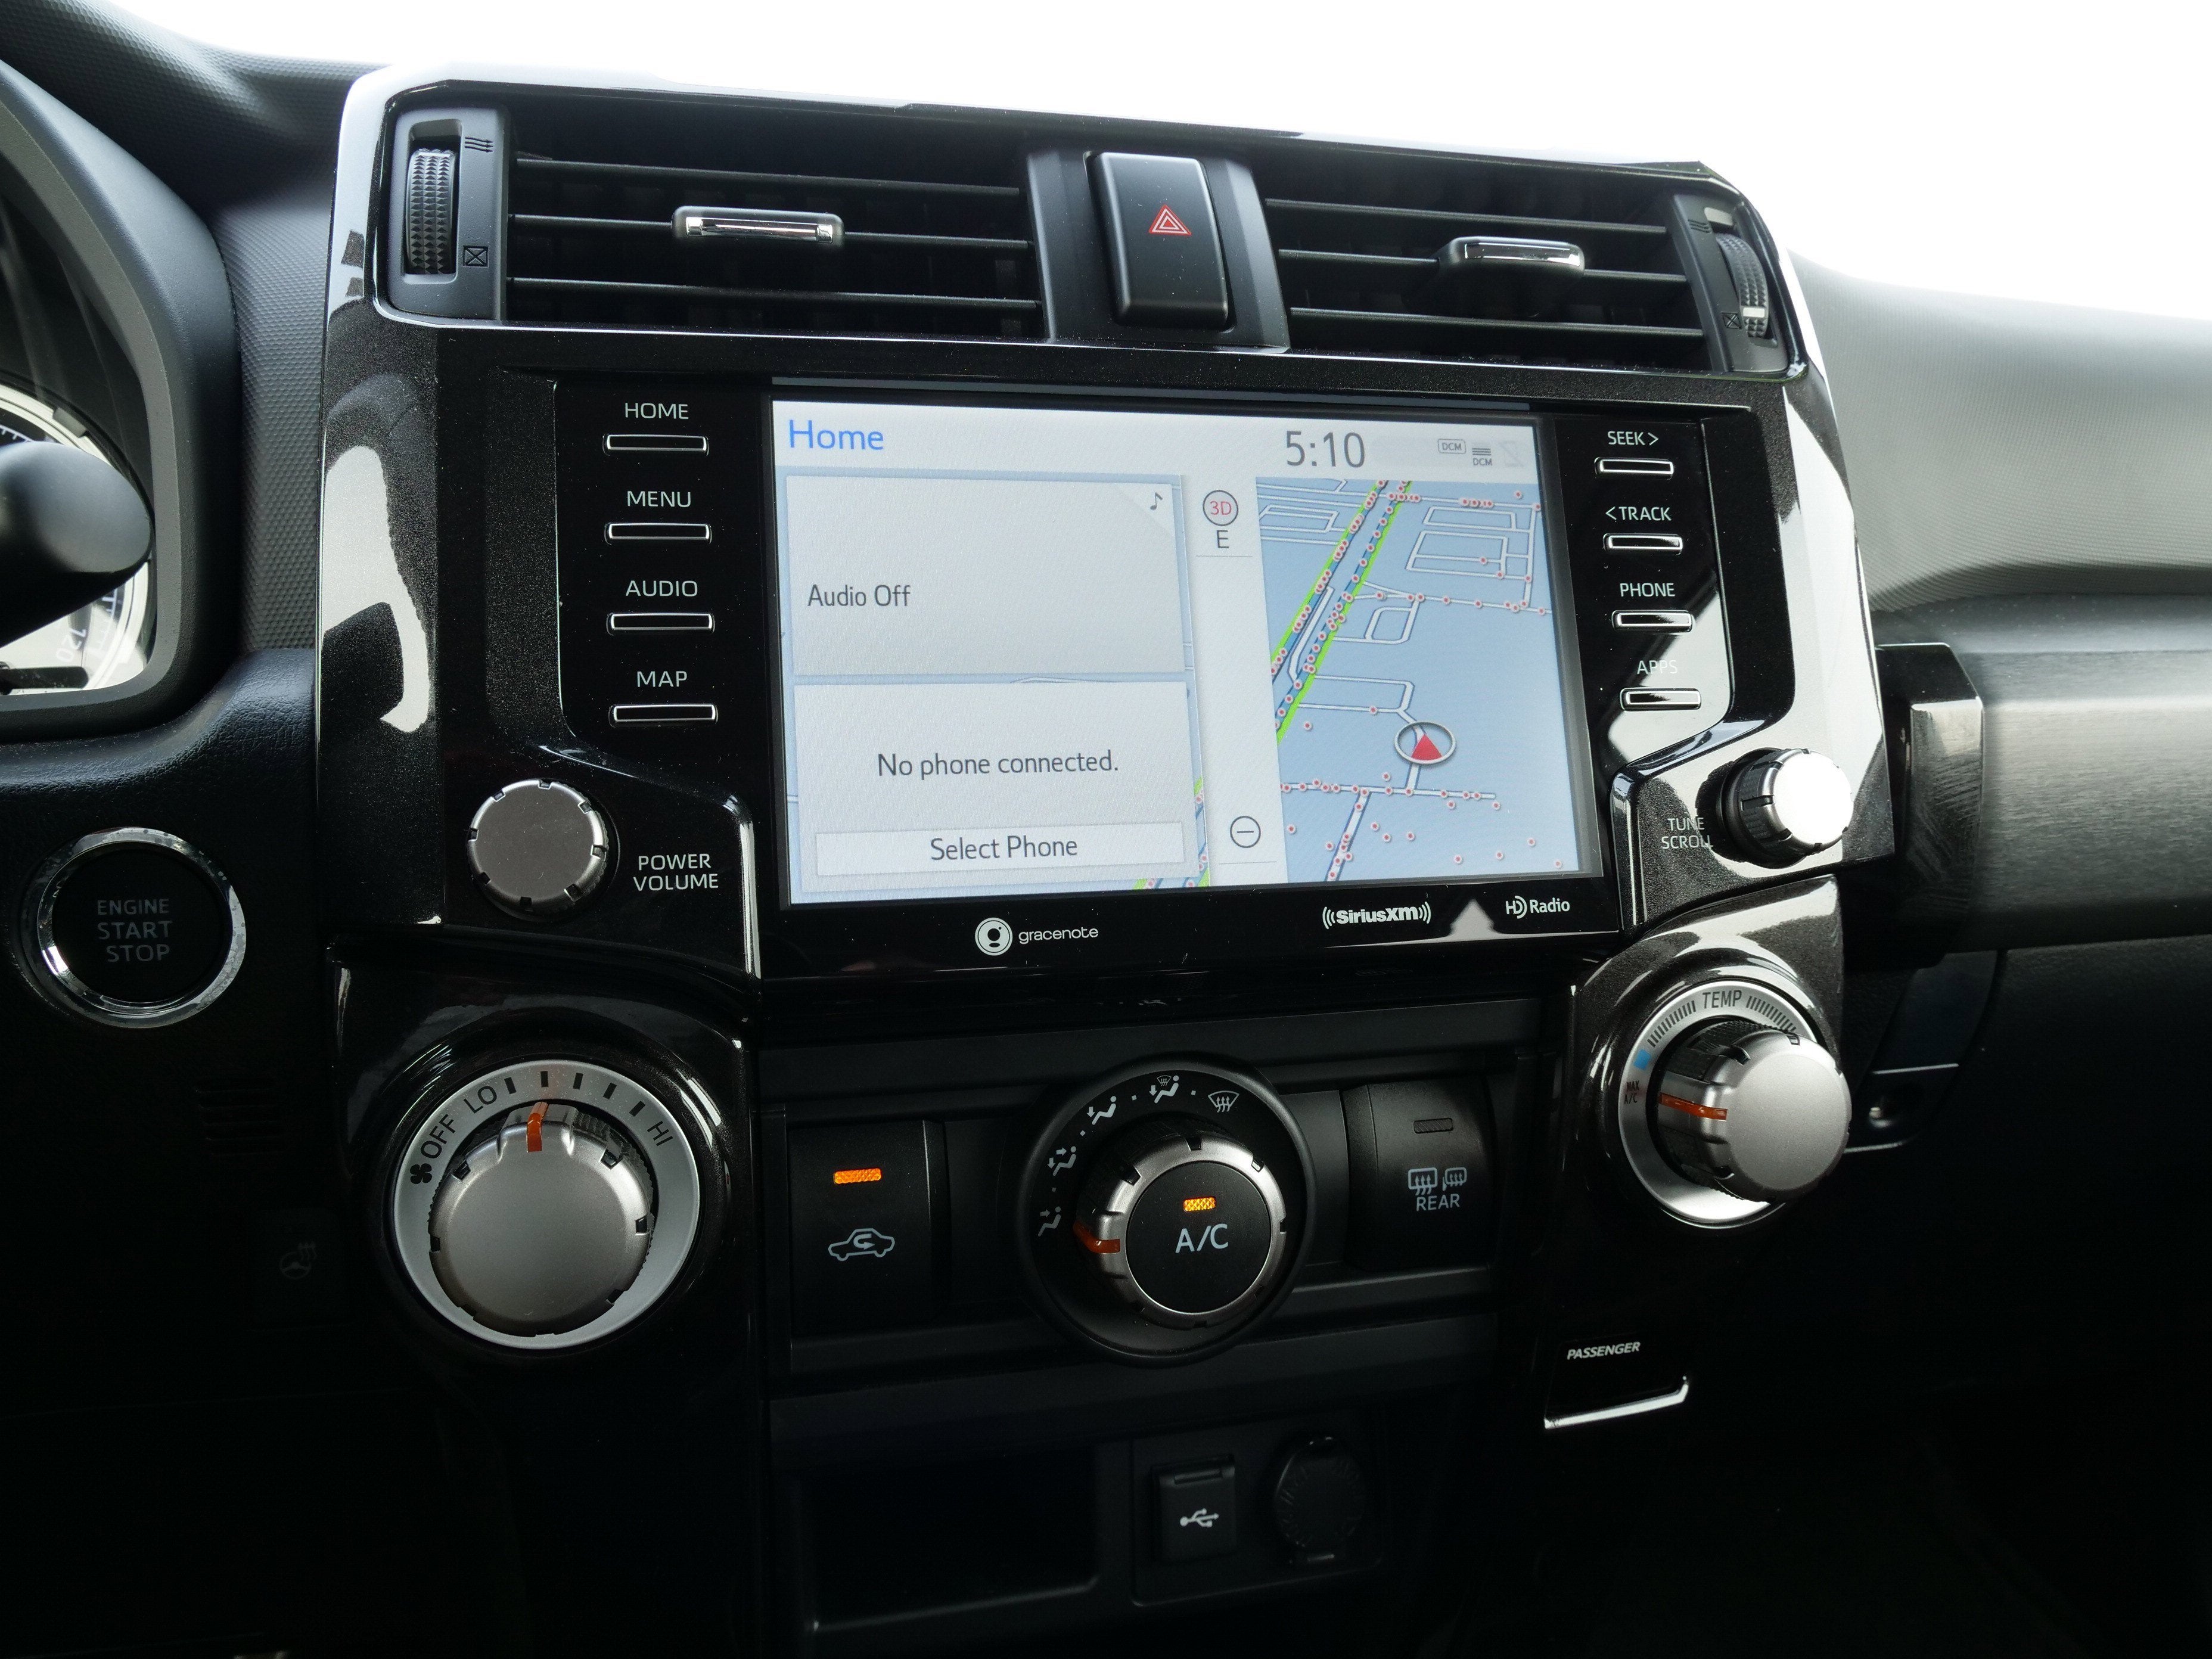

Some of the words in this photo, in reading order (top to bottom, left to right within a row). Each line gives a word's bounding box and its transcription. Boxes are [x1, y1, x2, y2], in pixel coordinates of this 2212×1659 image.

[625, 403, 689, 420] HOME
[788, 420, 884, 451] Home
[1285, 430, 1366, 468] 5:10
[1442, 442, 1462, 451] DCM
[1472, 458, 1493, 466] DCM
[627, 490, 691, 507] MENU
[1210, 500, 1233, 516] 3D
[1216, 530, 1230, 549] E
[625, 580, 698, 597] AUDIO
[807, 583, 867, 607] Audio
[874, 583, 911, 607] Off
[1620, 582, 1676, 597] PHONE
[1636, 659, 1678, 675] APPS
[636, 671, 688, 688] MAP
[878, 753, 913, 776] No
[921, 752, 990, 781] phone
[998, 749, 1119, 774] connected.
[1667, 817, 1705, 831] TUNE
[930, 837, 1001, 860] Select
[1007, 835, 1078, 858] Phone
[1661, 835, 1714, 849] SCROLL
[638, 853, 712, 871] POWER
[633, 873, 719, 891] VOLUME
[97, 898, 170, 915] ENGINE
[1530, 897, 1570, 914] Radio
[97, 920, 173, 940] START
[1018, 927, 1099, 945] gracenote
[106, 944, 170, 963] STOP
[1702, 989, 1742, 1009] TEMP
[463, 1085, 498, 1114] LO
[1624, 1093, 1638, 1105] A/C
[420, 1114, 458, 1160] OFF
[647, 1121, 674, 1147] HI
[1416, 1194, 1460, 1212] REAR
[1175, 1223, 1229, 1254] A/C
[1567, 1341, 1641, 1360] PASSENGER
